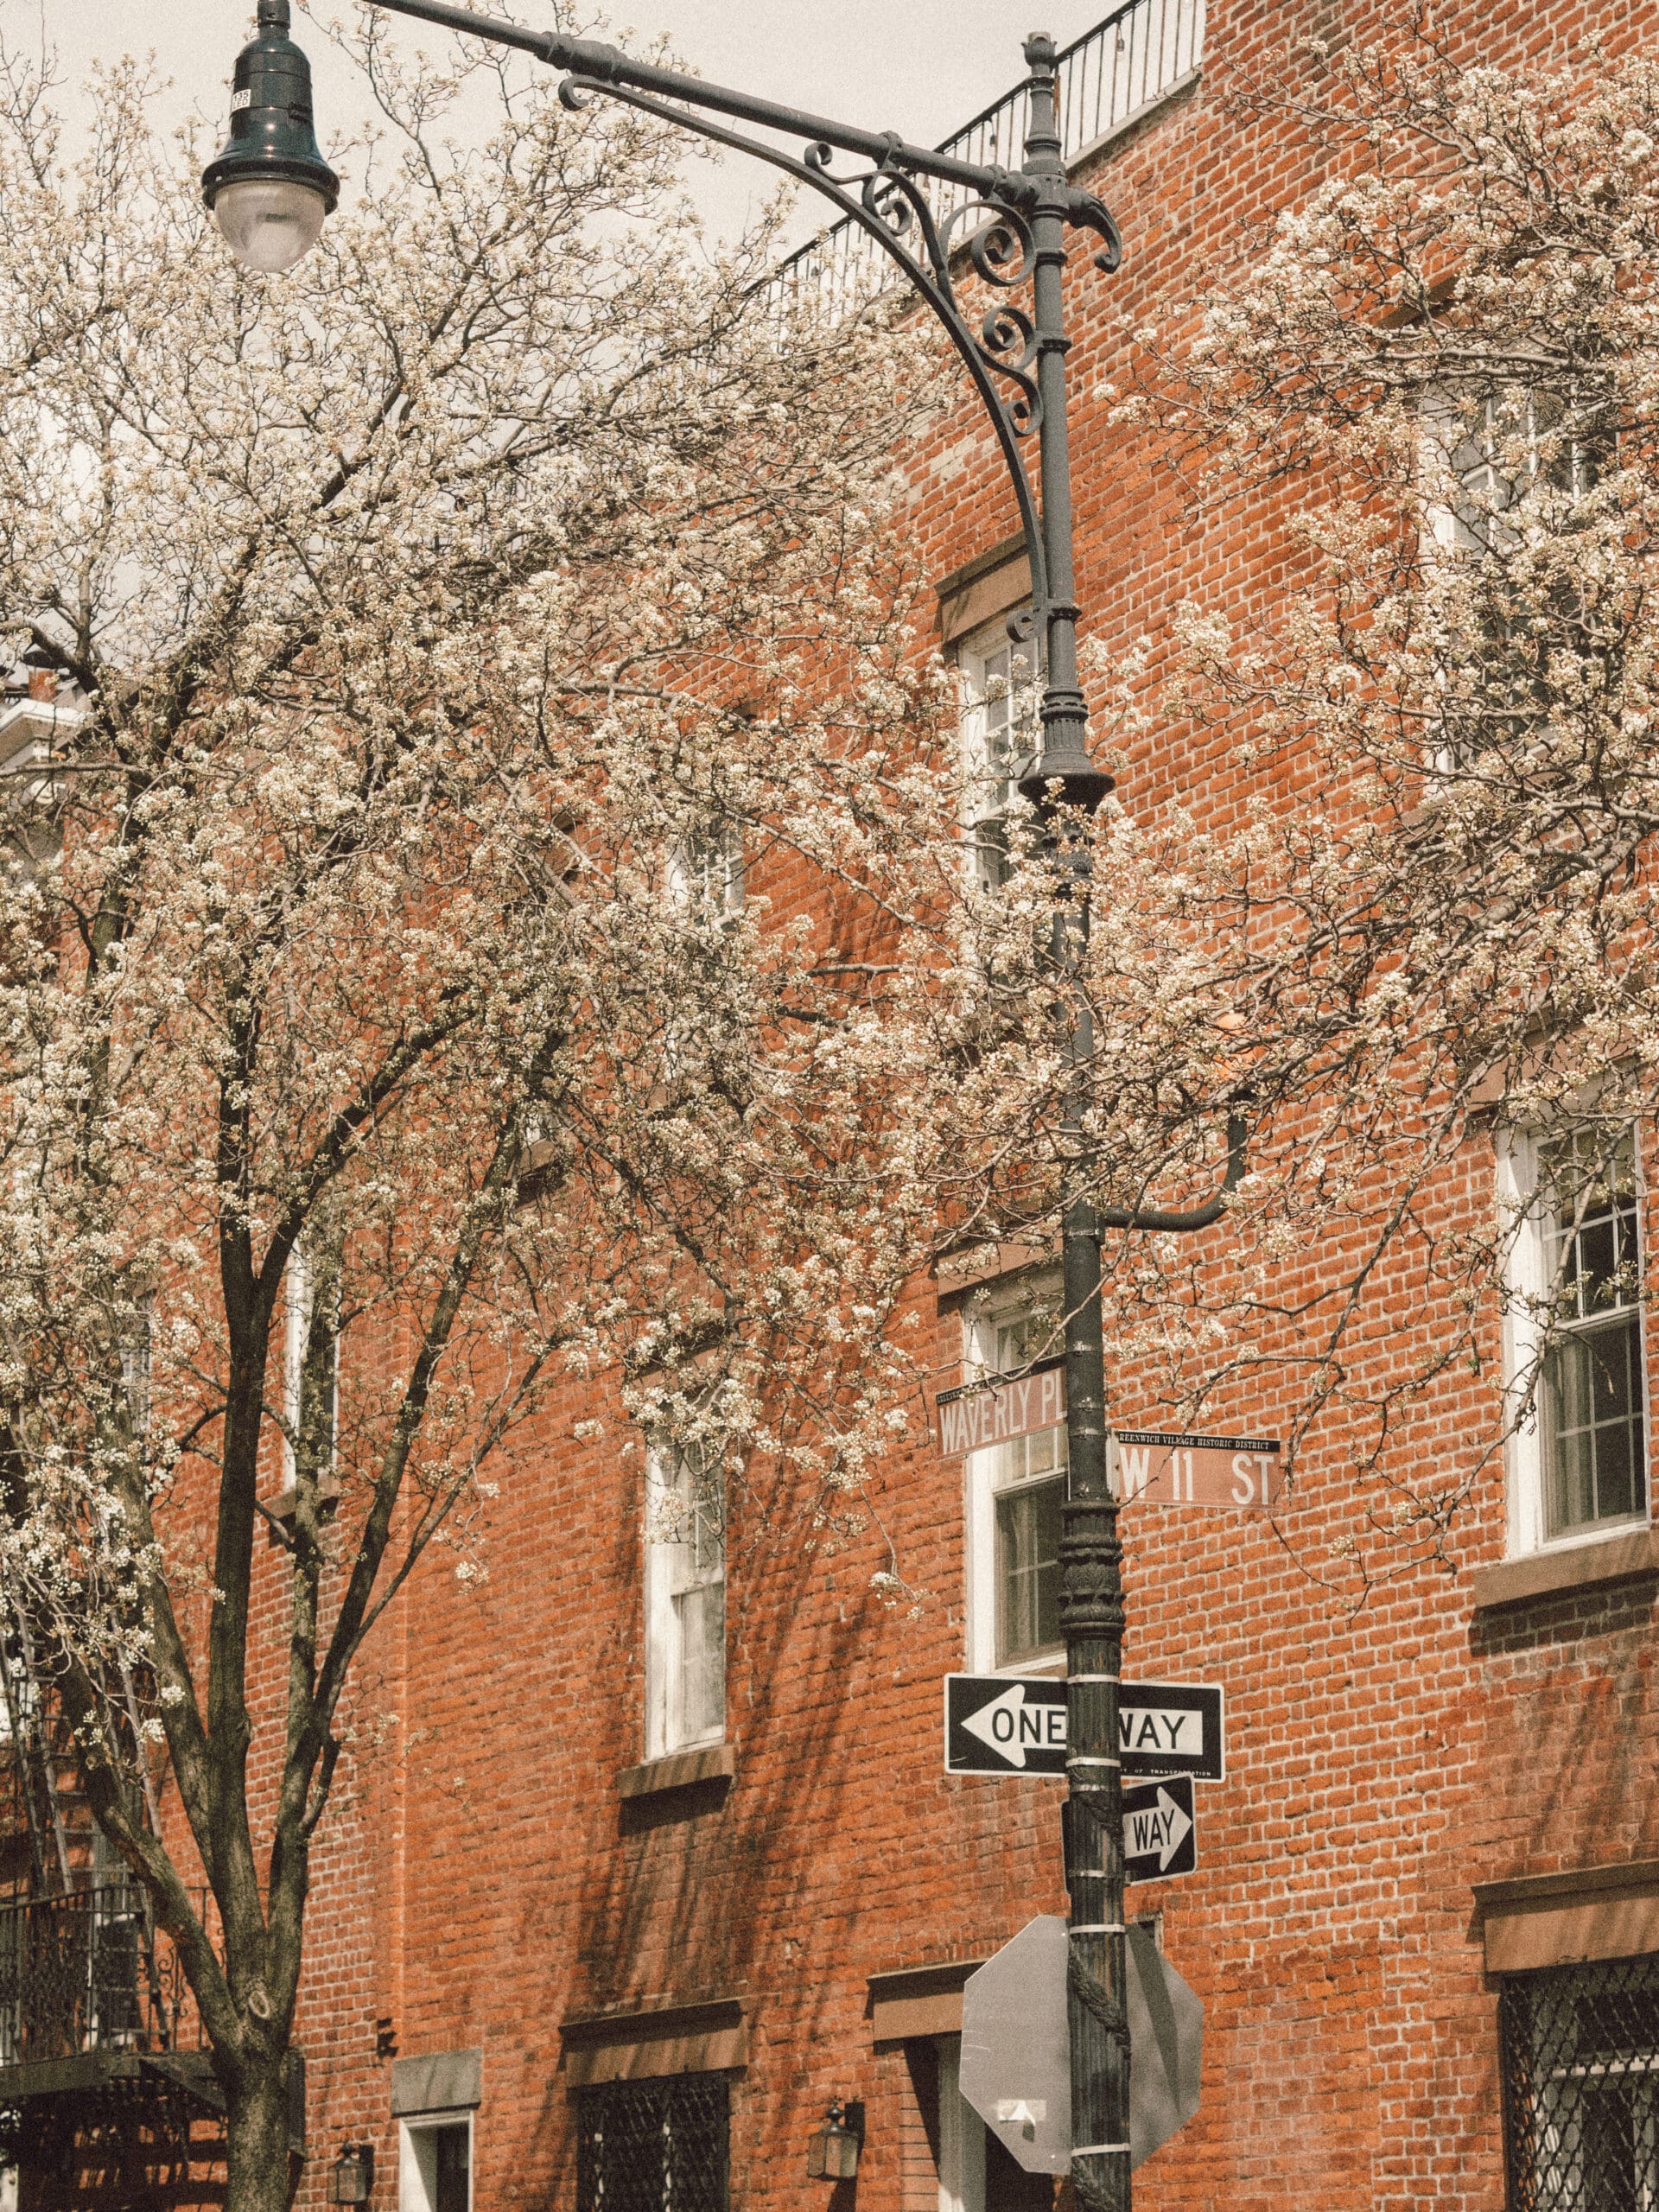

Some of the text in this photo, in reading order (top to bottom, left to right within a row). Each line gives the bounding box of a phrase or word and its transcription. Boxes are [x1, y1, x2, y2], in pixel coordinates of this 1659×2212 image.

[232, 99, 248, 110] LED
[234, 91, 249, 102] 135
[939, 1381, 1031, 1455] WAVERLY
[1041, 1370, 1068, 1425] PL
[1119, 1433, 1269, 1450] REENWICH VILLAGE HISTORIC DISTRICT
[1119, 1447, 1274, 1505] W 11 ST
[992, 1707, 1067, 1745] ONE
[1133, 1808, 1176, 1853] WAY
